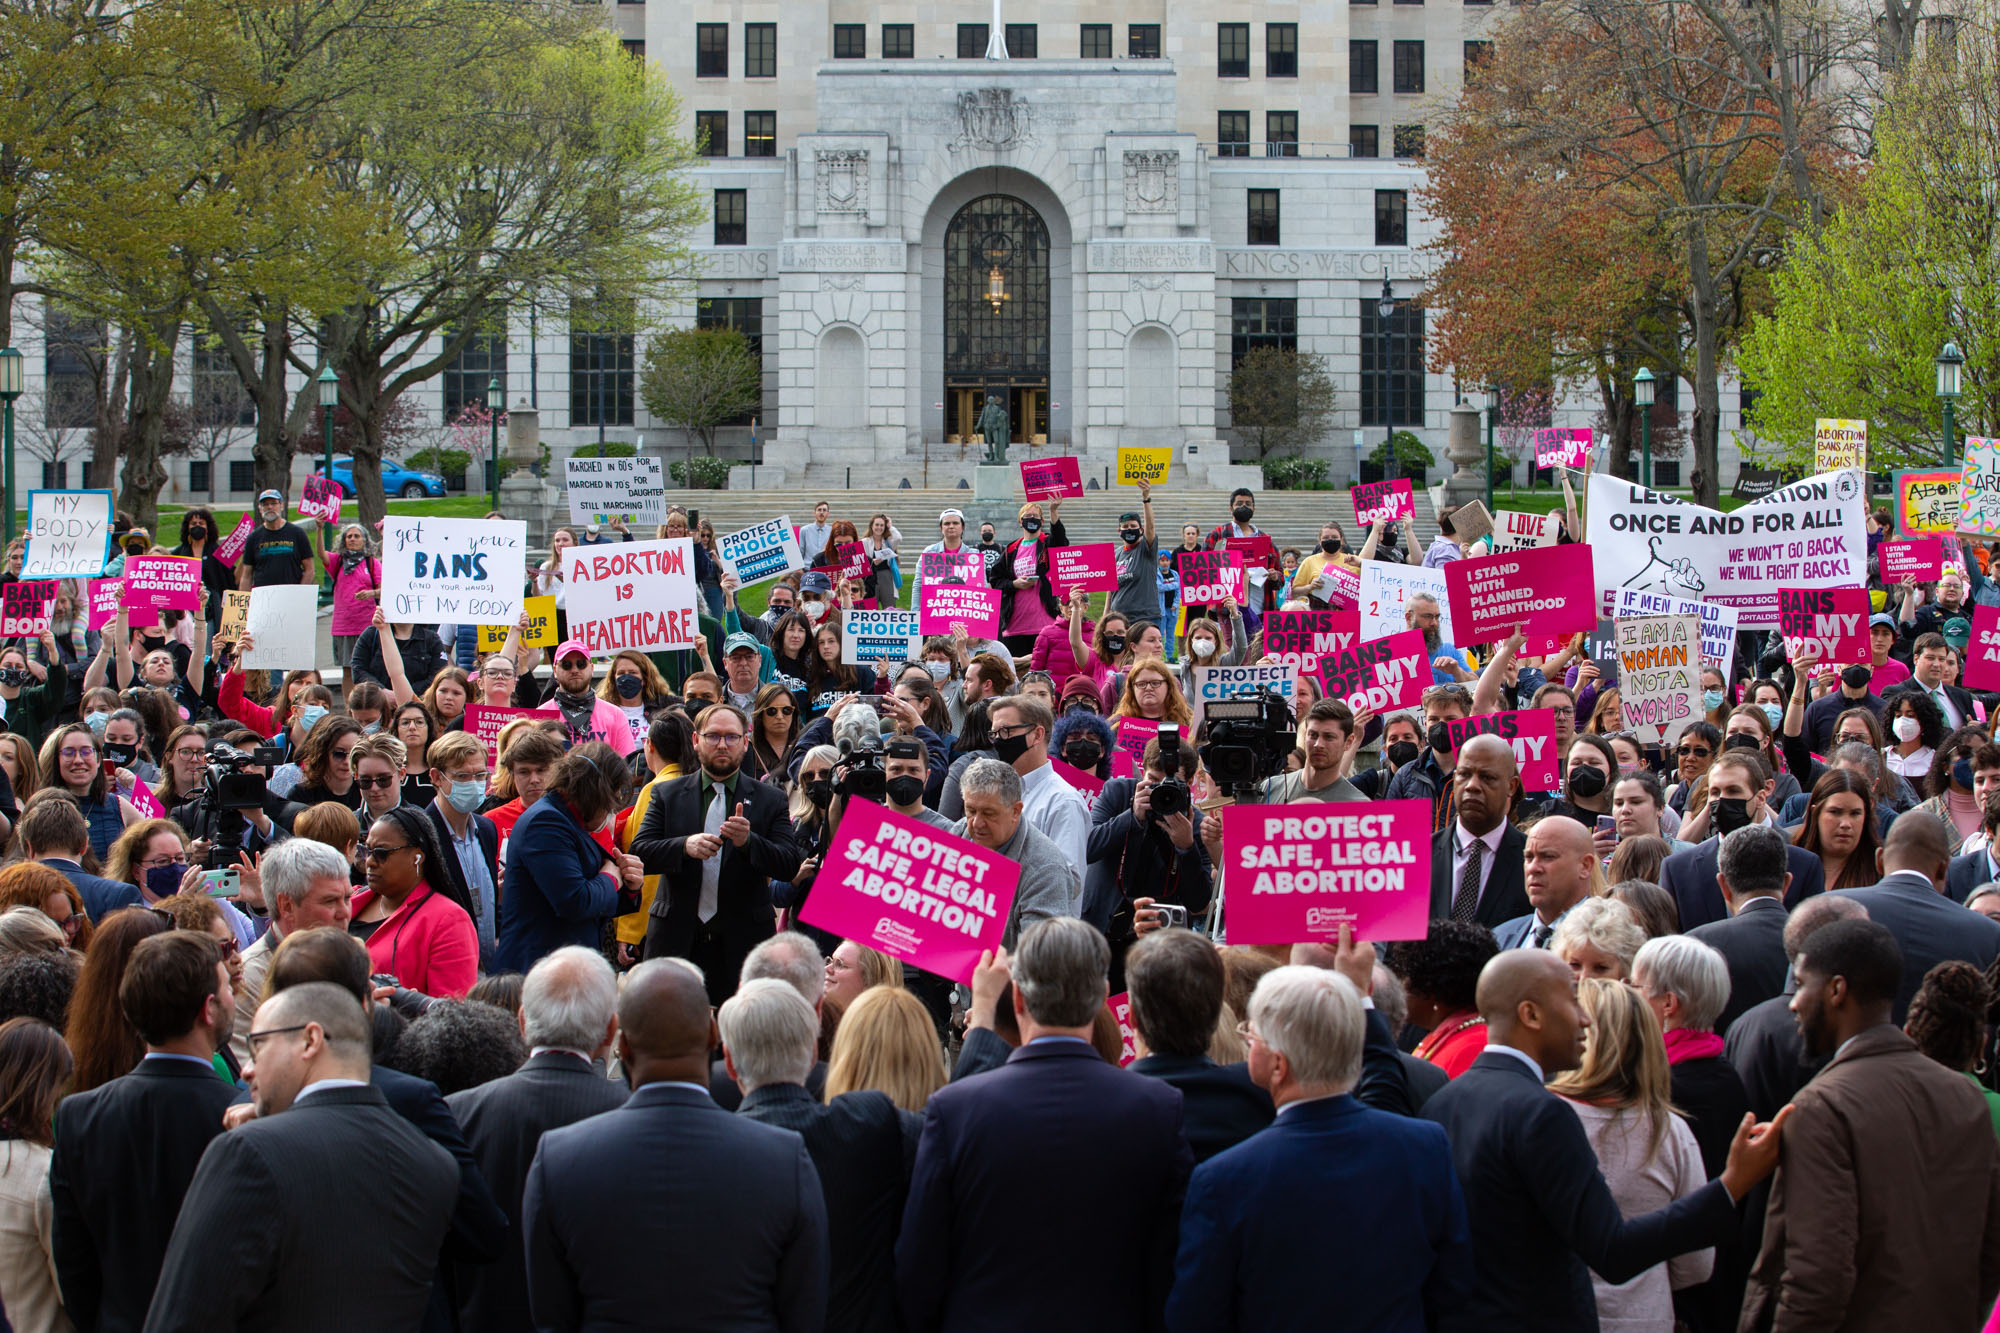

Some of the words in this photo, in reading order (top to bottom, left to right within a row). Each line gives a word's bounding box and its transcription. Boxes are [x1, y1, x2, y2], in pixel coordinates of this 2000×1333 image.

[808, 246, 876, 255] RENSSELAER
[1128, 245, 1190, 256] LAWRENCE
[800, 258, 885, 267] MONTGOMERY
[1110, 258, 1194, 267] SCHENECTADY
[1226, 252, 1299, 273] KINGS
[1536, 430, 1575, 442] BANS
[1816, 429, 1864, 440] ABORTION
[1537, 441, 1563, 454] OFF
[1564, 441, 1588, 453] MY
[1817, 442, 1841, 452] BANS
[1842, 442, 1864, 452] ARE
[569, 461, 602, 473] MARCHED
[608, 463, 615, 471] IN
[1124, 463, 1144, 471] OFF
[1145, 463, 1165, 471] OUR
[1125, 454, 1152, 463] BANS
[1538, 451, 1577, 467] BODY
[649, 465, 660, 473] ME
[1124, 471, 1160, 479] BODIES
[306, 476, 338, 495] BANS
[569, 481, 603, 489] MARCHED
[605, 481, 613, 489] IN
[634, 476, 648, 484] FOR
[1354, 482, 1394, 500] BANS
[304, 489, 328, 504] OFF
[328, 494, 342, 511] MY
[628, 488, 664, 497] DAUGHTER
[54, 495, 81, 514] MY
[300, 501, 335, 520] BODY
[580, 501, 599, 510] STILL
[603, 501, 643, 510] MARCHING
[1357, 496, 1383, 512] OFF
[1384, 492, 1408, 508] MY
[1358, 507, 1398, 525] BODY
[1507, 513, 1547, 537] LOVE
[1609, 513, 1681, 534] ONCE
[1689, 516, 1745, 535] AND
[1752, 513, 1795, 534] FOR
[1801, 509, 1843, 531] ALL!
[36, 518, 101, 538] BODY
[722, 519, 782, 548] PROTECT
[395, 521, 424, 552] get
[469, 535, 518, 557] your
[723, 528, 791, 560] CHOICE
[1513, 537, 1537, 547] THE
[51, 541, 76, 559] MY
[743, 549, 776, 564] MICHELLE
[1729, 549, 1745, 563] WE
[1747, 544, 1784, 562] WON'T
[1788, 542, 1803, 557] GO
[1807, 535, 1847, 555] BACK
[29, 559, 101, 574] CHOICE
[139, 560, 188, 571] PROTECT
[414, 551, 488, 581] BANS
[572, 546, 686, 583] ABORTION
[739, 554, 786, 576] OSTRELICH
[852, 553, 866, 565] MY
[924, 554, 965, 565] BANS
[1181, 552, 1231, 570] BANS
[1886, 557, 1918, 565] PLANNED
[1887, 563, 1932, 572] PARENTHOOD
[129, 571, 159, 581] SAFE,
[162, 572, 196, 582] LEGAL
[924, 566, 952, 577] OFF
[953, 566, 980, 577] MY
[1058, 565, 1089, 573] PLANNED
[1058, 571, 1106, 580] PARENTHOOD
[1182, 569, 1217, 586] OFF
[1220, 568, 1241, 584] MY
[1369, 566, 1403, 587] There
[1467, 571, 1472, 582] I
[1474, 563, 1520, 581] STAND
[1719, 565, 1735, 580] WE
[1737, 564, 1762, 580] WILL
[1766, 562, 1800, 580] FIGHT
[1803, 557, 1851, 579] BACK!
[6, 583, 54, 600] BANS
[131, 580, 192, 592] ABORTION
[441, 583, 460, 591] YOUR
[465, 583, 494, 593] HANDS)
[616, 583, 634, 602] IS
[936, 589, 987, 600] PROTECT
[1184, 583, 1235, 603] BODY
[1381, 588, 1390, 600] in
[1397, 588, 1403, 602] 1
[1469, 578, 1505, 595] WITH
[396, 593, 427, 615] OFF
[437, 596, 460, 613] MY
[469, 598, 513, 616] BODY
[927, 599, 958, 608] SAFE,
[960, 599, 994, 612] LEGAL
[1470, 587, 1534, 608] PLANNED
[1623, 591, 1637, 606] IF
[1640, 594, 1671, 613] MEN
[1679, 602, 1720, 621] COULD
[1707, 596, 1733, 606] PARTY
[1736, 597, 1753, 605] FOR
[1780, 591, 1835, 614] BANS
[4, 600, 41, 618] OFF
[851, 612, 917, 622] PROTECT
[930, 608, 989, 621] ABORTION
[1370, 601, 1379, 617] 2
[1472, 597, 1566, 621] PARENTHOOD
[572, 608, 694, 652] HEALTHCARE
[847, 622, 919, 635] CHOICE
[1267, 613, 1332, 633] BANS
[1480, 623, 1501, 633] Planned
[1782, 614, 1813, 636] OFF
[1815, 613, 1860, 637] MY
[1623, 626, 1637, 644] I
[1641, 622, 1668, 645] AM
[1672, 621, 1687, 642] A
[857, 646, 907, 654] OSTRELICH
[1267, 633, 1311, 652] OFF
[1313, 632, 1354, 653] MY
[1784, 636, 1841, 660] BODY
[1320, 638, 1393, 680] BANS
[1621, 645, 1688, 674] WOMAN
[1207, 666, 1290, 682] PROTECT
[1326, 666, 1375, 699] OFF
[1375, 653, 1421, 686] MY
[1631, 673, 1668, 696] NOT
[1670, 671, 1689, 690] A
[478, 711, 482, 719] I
[1624, 693, 1690, 727] WOMB
[478, 720, 505, 730] WITH
[1264, 814, 1395, 841] PROTECT
[875, 821, 990, 883] PROTECT
[1240, 844, 1323, 869] SAFE,
[1331, 840, 1417, 866] LEGAL
[844, 838, 916, 886] SAFE,
[921, 867, 997, 918] LEGAL
[1252, 868, 1405, 895] ABORTION
[841, 867, 984, 939] ABORTION
[892, 920, 916, 935] Planned
